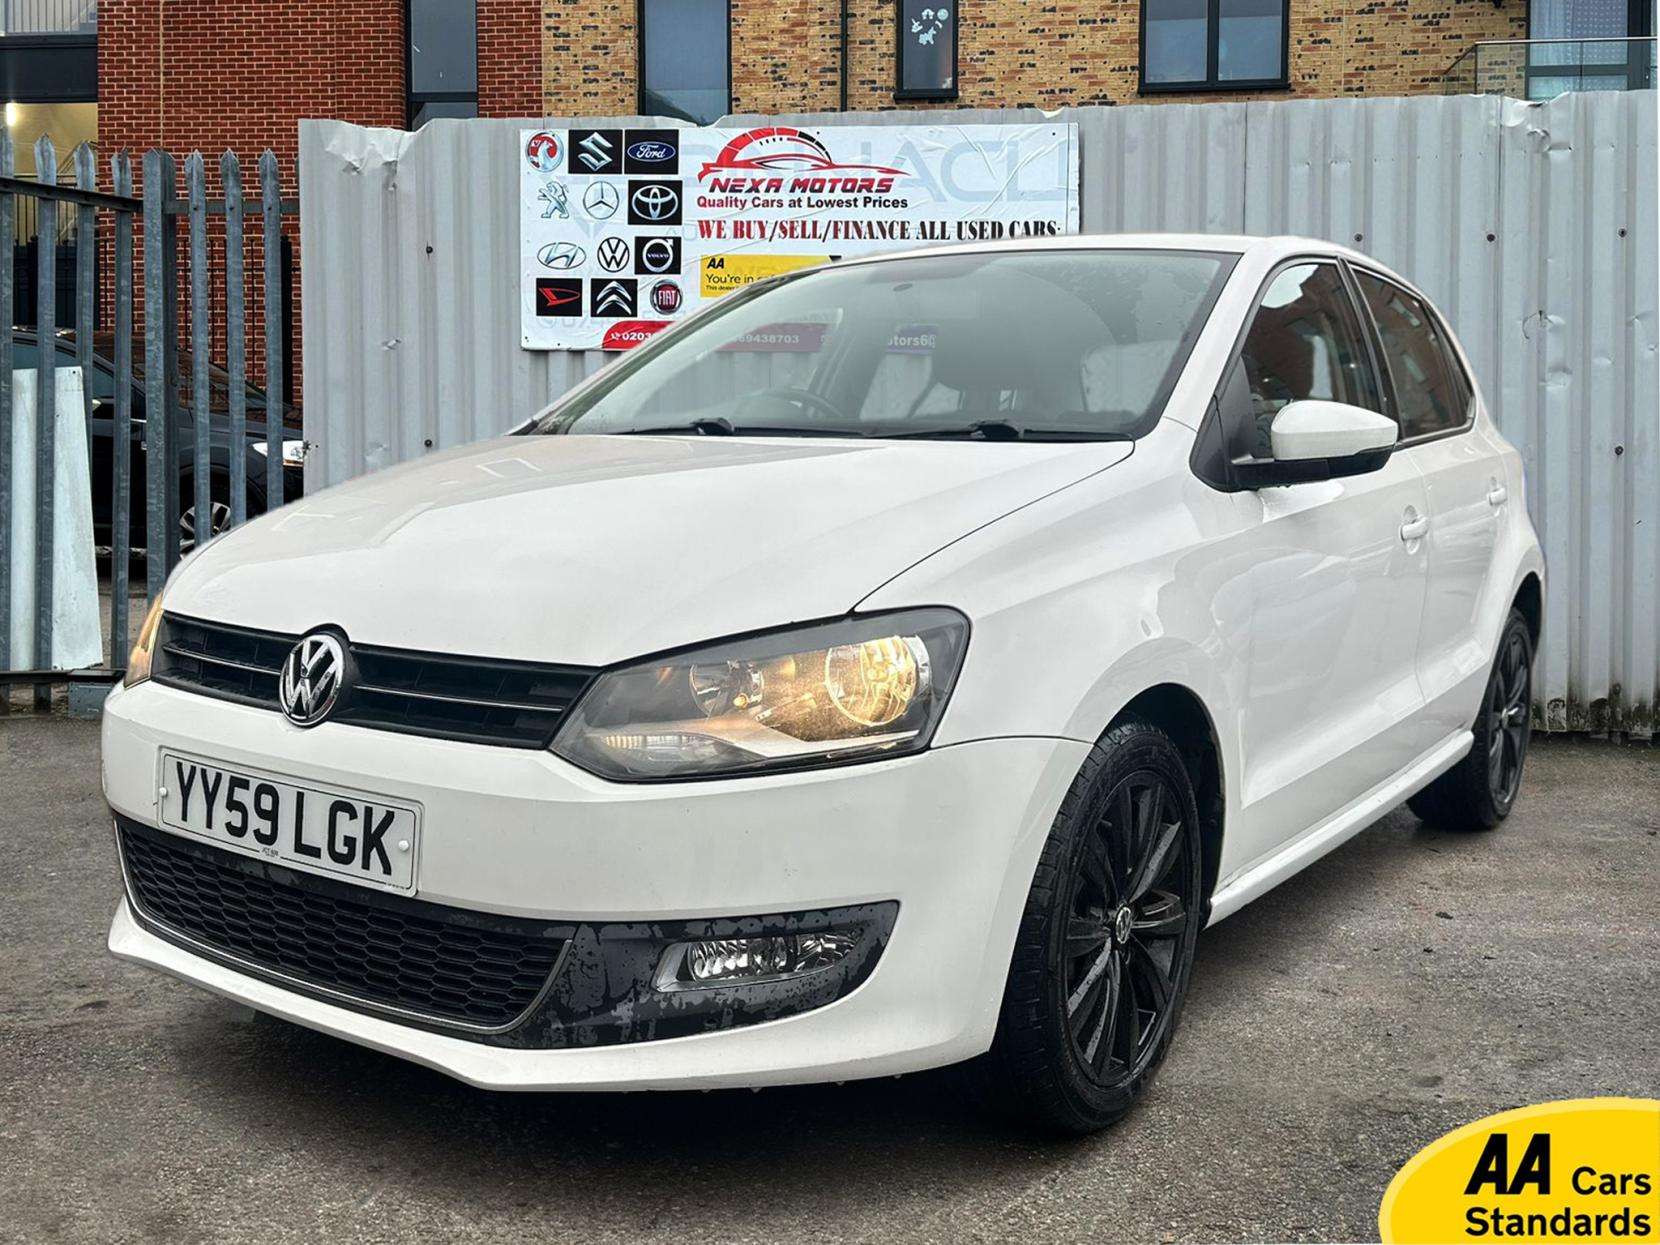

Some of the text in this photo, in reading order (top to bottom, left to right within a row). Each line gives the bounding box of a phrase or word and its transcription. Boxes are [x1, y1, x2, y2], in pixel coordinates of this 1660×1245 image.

[636, 144, 666, 158] Ford
[709, 177, 894, 193] NEXA MOTORS
[697, 196, 908, 210] Quality Cars at Lowest Prices
[698, 220, 727, 240] WE
[733, 220, 911, 242] BUY/SELL/FINANCE
[916, 220, 951, 240] ALL
[956, 220, 1004, 241] USED
[707, 257, 724, 269] AA
[706, 274, 741, 284] You're
[744, 274, 754, 283] in
[658, 290, 676, 305] FIAT
[622, 332, 653, 341] 0203
[176, 761, 395, 876] YY59 LGK
